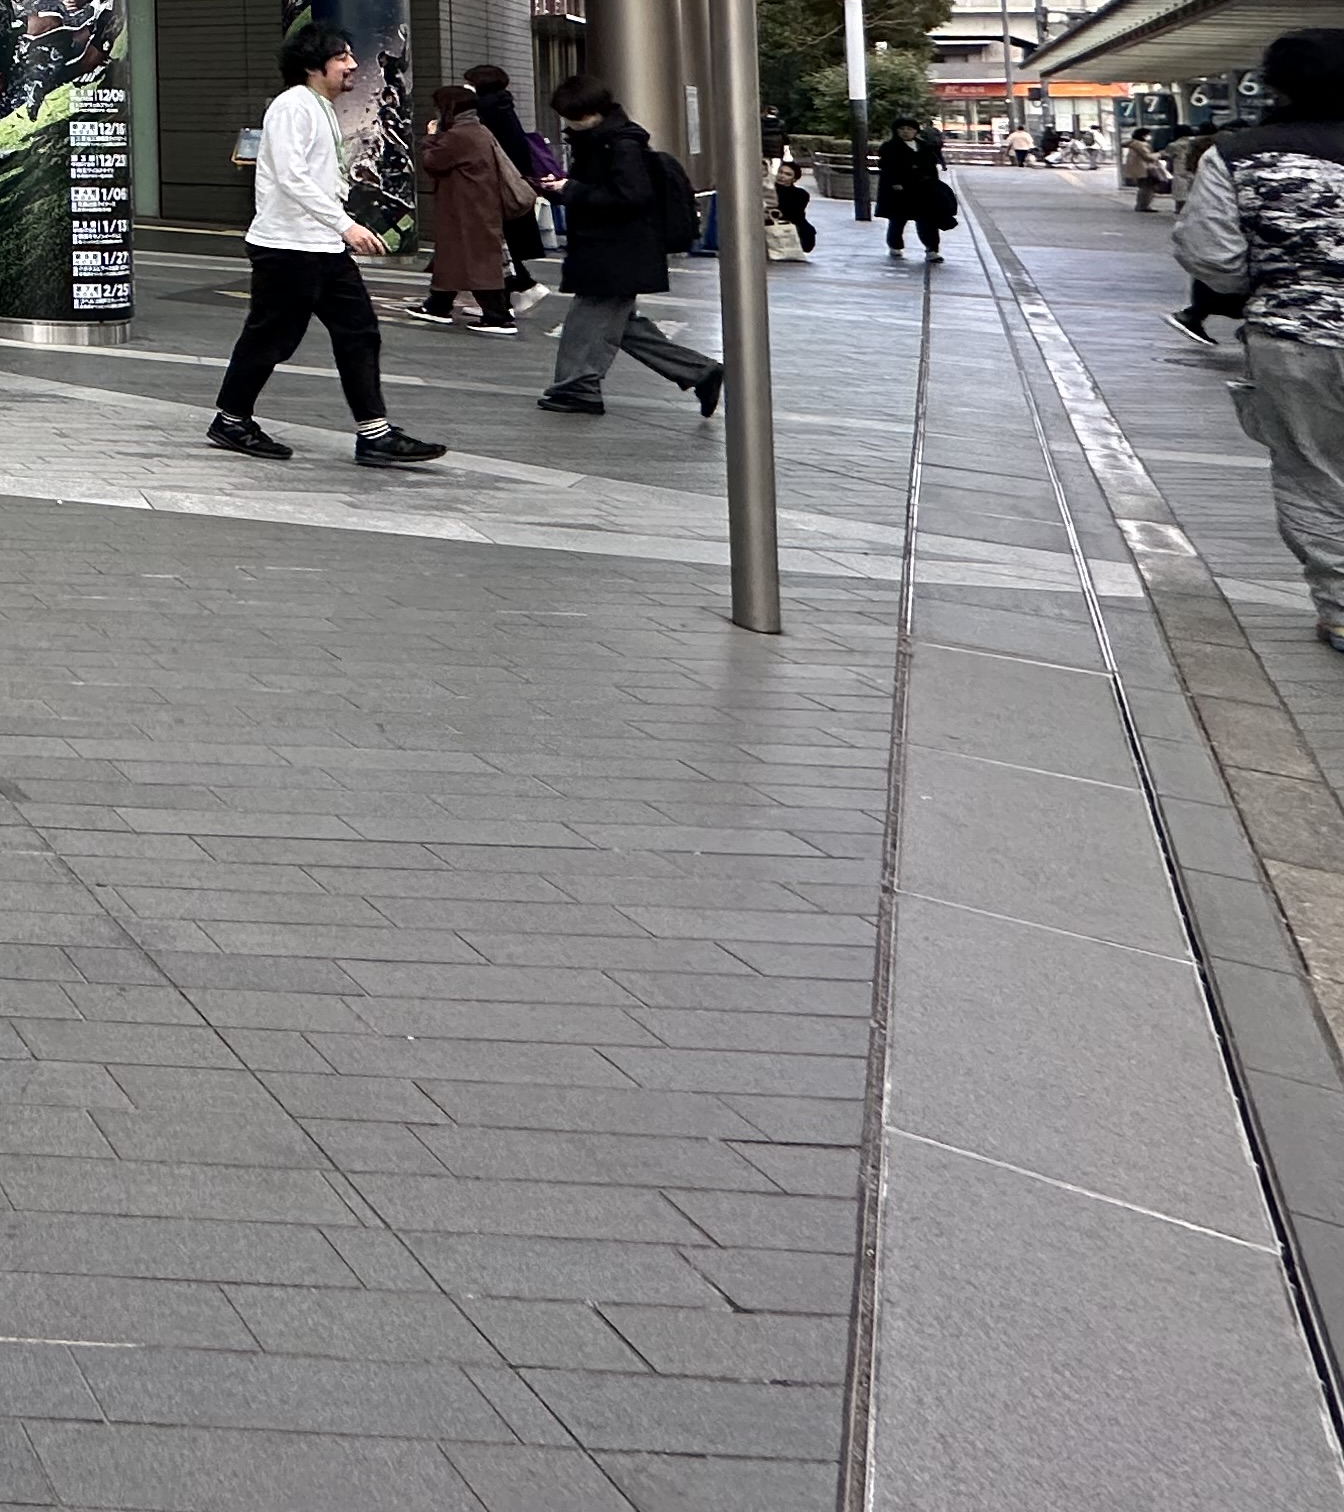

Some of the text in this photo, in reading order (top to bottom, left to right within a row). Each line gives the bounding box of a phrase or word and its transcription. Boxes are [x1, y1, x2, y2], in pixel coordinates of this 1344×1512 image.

[1238, 71, 1259, 95] 6
[1144, 95, 1159, 112] 7
[1190, 84, 1208, 106] 6
[1121, 101, 1134, 116] 7
